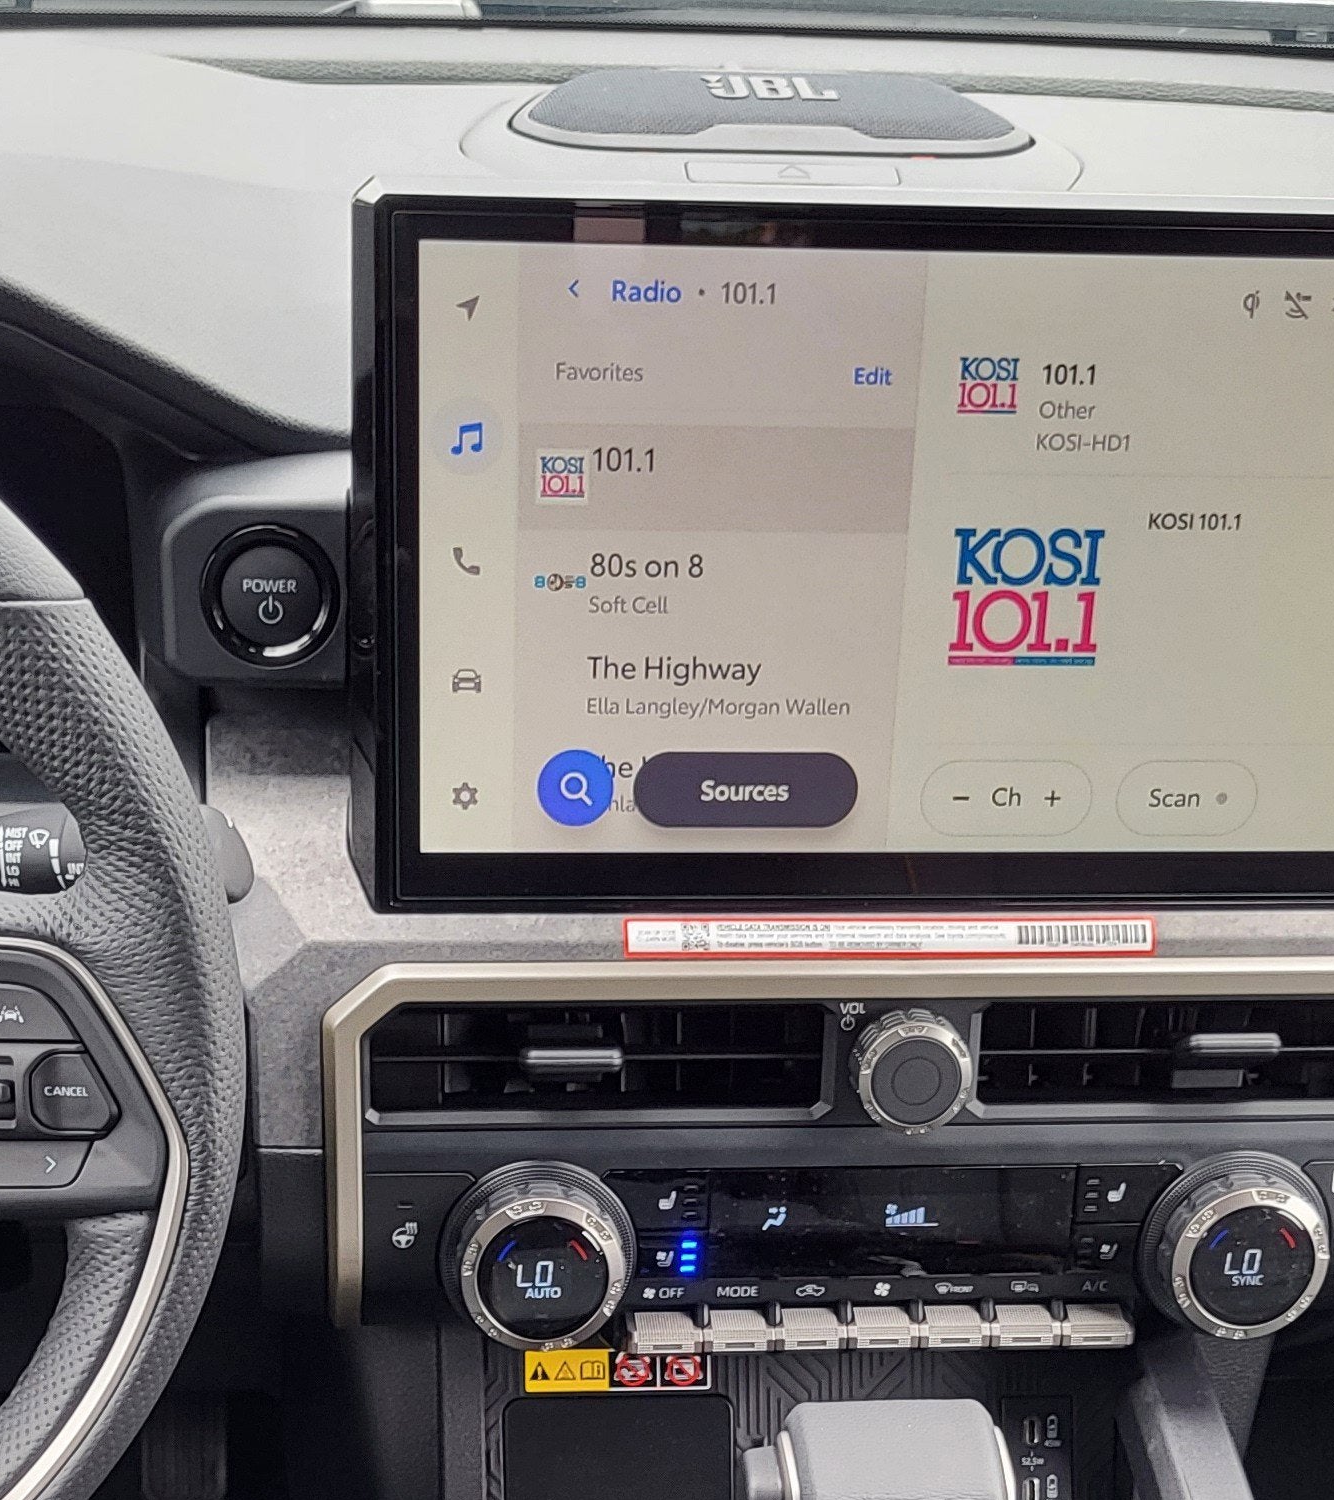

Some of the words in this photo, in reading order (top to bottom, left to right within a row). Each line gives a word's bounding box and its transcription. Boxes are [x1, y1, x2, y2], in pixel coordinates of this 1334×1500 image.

[703, 75, 840, 101] JBL
[612, 279, 682, 304] Radio
[720, 282, 776, 305] 101.1
[555, 362, 644, 383] Favorites
[853, 367, 893, 387] Edit
[960, 358, 1020, 382] KOSI
[1042, 364, 1097, 387] 101.1
[957, 383, 1018, 411] 101.1
[1039, 400, 1096, 421] Other
[1036, 432, 1131, 453] KOSI-HD1
[540, 456, 585, 475] KOSI
[592, 447, 655, 473] 101.1
[540, 475, 585, 494] 101.1
[1148, 513, 1194, 532] KOSI
[1198, 513, 1242, 532] 101.1
[590, 553, 637, 578] 80s
[645, 560, 679, 578] on
[688, 554, 704, 578] 8
[954, 528, 1106, 586] KOSI
[242, 578, 297, 593] POWER
[588, 596, 627, 615] Soft
[632, 597, 668, 615] Cell
[948, 590, 1097, 653] 101.1
[587, 655, 637, 680] The
[644, 656, 762, 686] Highway
[586, 697, 620, 716] Ella
[625, 698, 780, 719] Langley/Morgan
[785, 699, 850, 716] Wallen
[700, 780, 790, 803] Sources
[991, 787, 1021, 808] Ch
[1148, 788, 1201, 809] Scan
[5, 839, 23, 851] OFF
[839, 1002, 865, 1014] VOL
[44, 1086, 89, 1097] CANCEL
[1082, 1280, 1108, 1292] A/C
[1231, 1273, 1264, 1287] SYNC
[525, 1286, 562, 1300] AUTO
[658, 1286, 685, 1300] OFF
[716, 1284, 759, 1298] MODE
